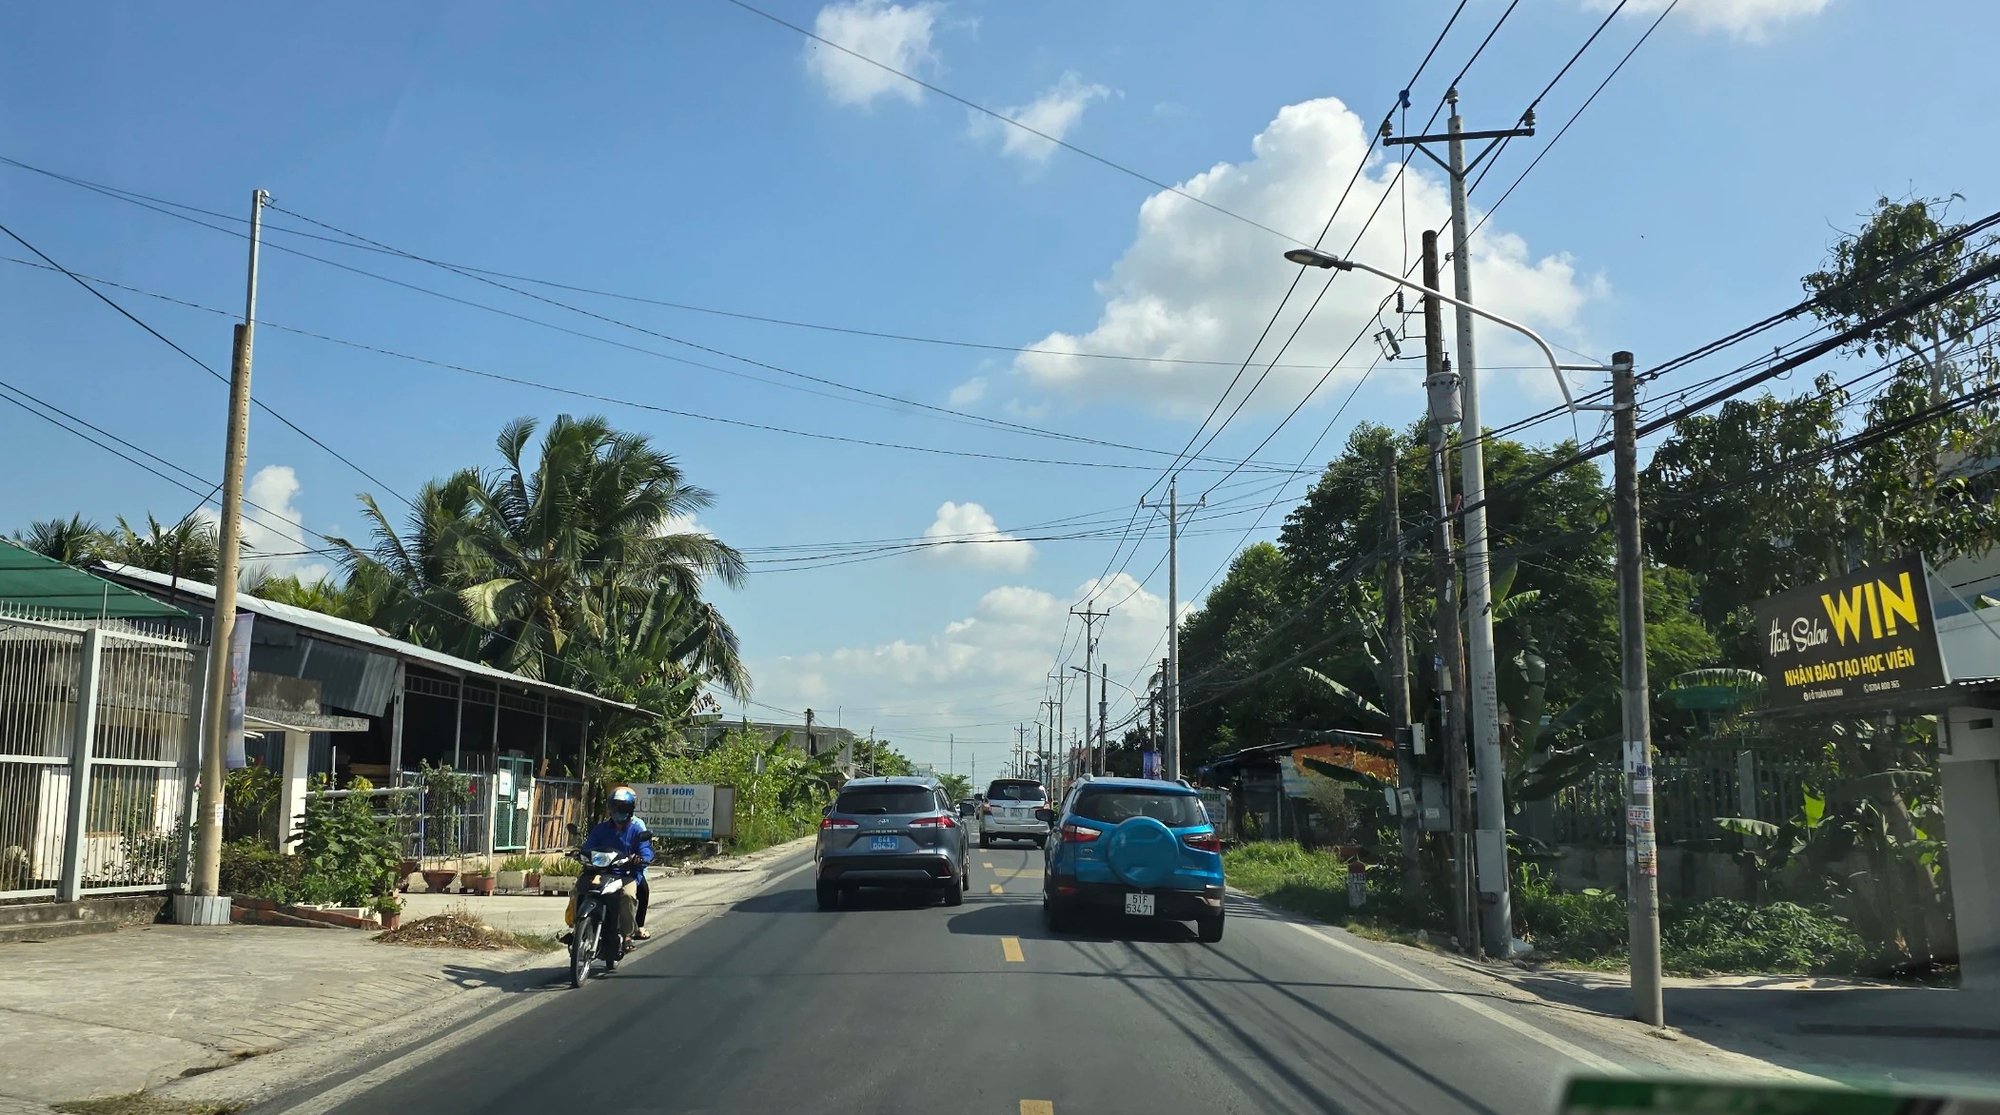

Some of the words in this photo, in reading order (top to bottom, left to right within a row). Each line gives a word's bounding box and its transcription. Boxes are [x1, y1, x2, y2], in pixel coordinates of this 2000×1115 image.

[1820, 572, 1920, 646] WIN
[1768, 617, 1791, 657] Hair
[1791, 617, 1828, 652] Salon
[1784, 664, 1814, 688] NHẬN
[1814, 660, 1837, 681] ĐÀO
[1838, 659, 1860, 681] TẠO
[1862, 654, 1885, 677] HỌC
[1885, 646, 1915, 670] VIÊN
[647, 787, 669, 797] TRẠI
[1132, 894, 1148, 904] 51F
